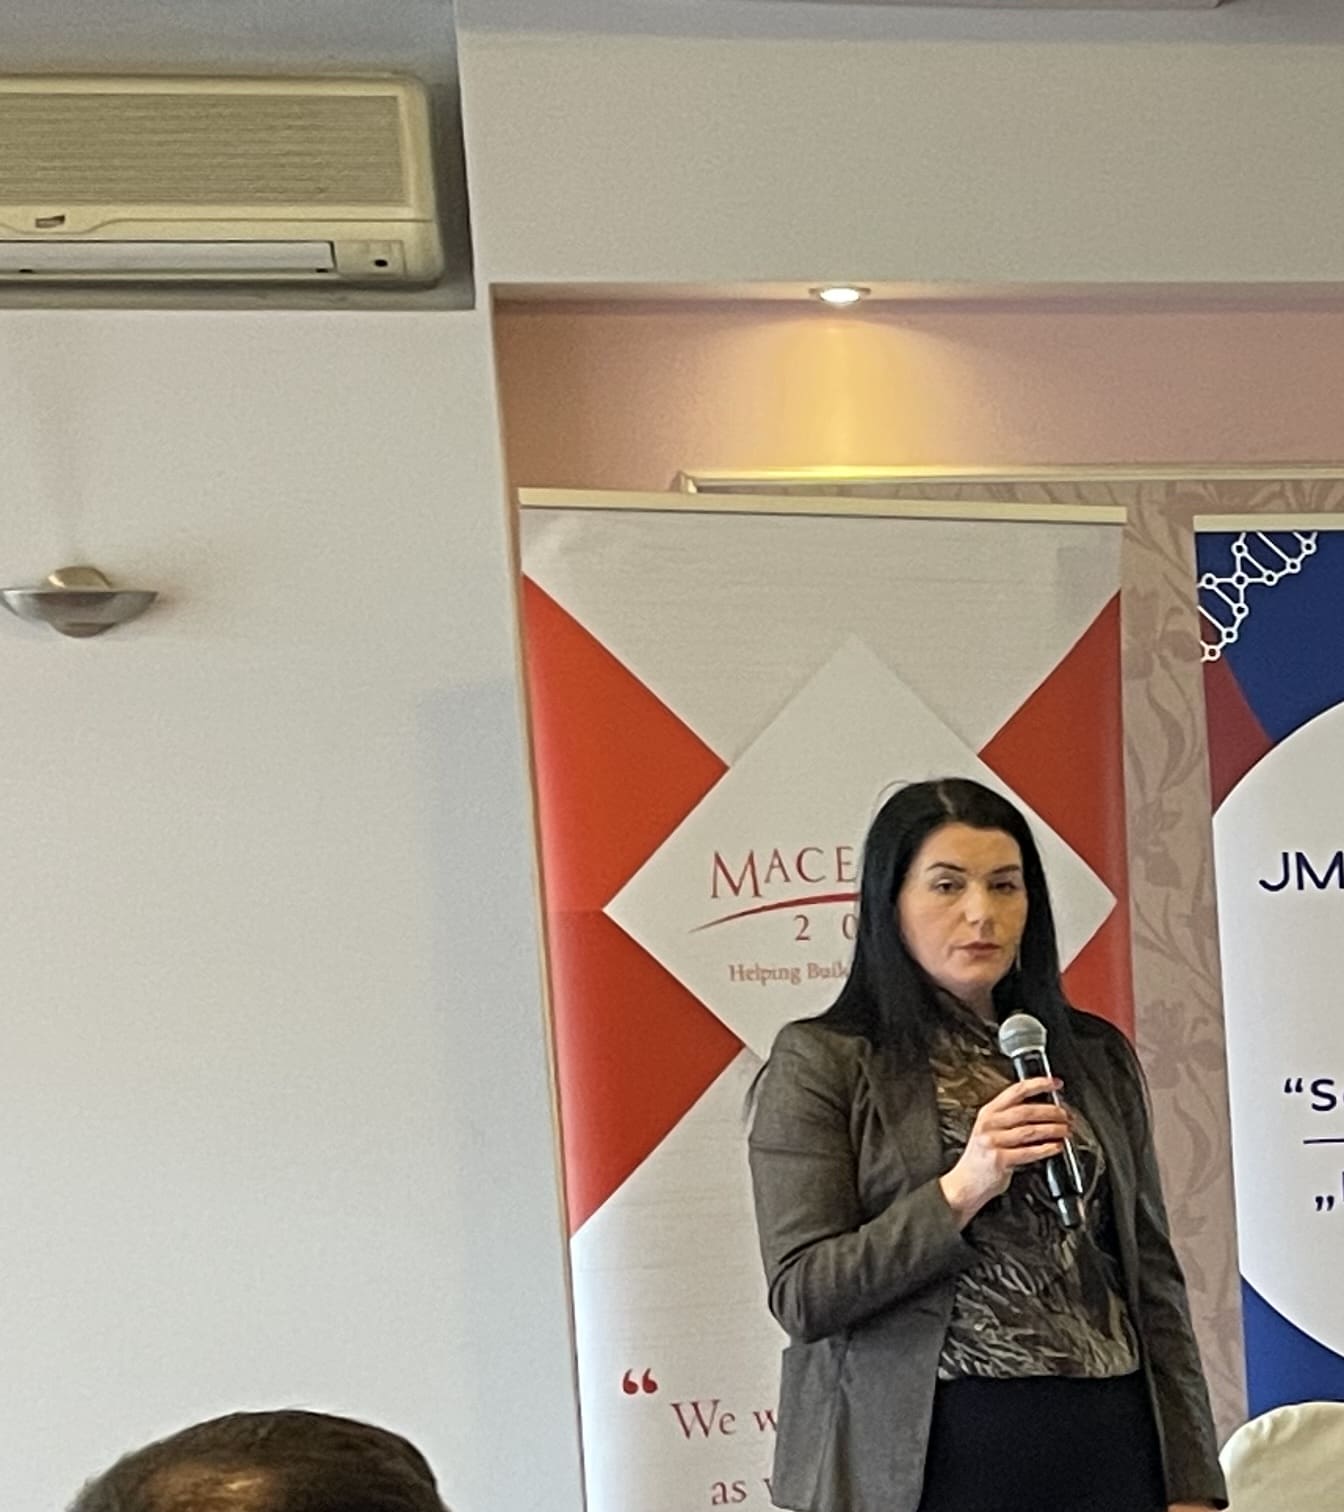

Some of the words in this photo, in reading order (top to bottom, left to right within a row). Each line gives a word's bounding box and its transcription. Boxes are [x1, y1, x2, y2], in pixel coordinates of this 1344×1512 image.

[711, 845, 858, 899] MACE
[728, 963, 803, 987] Helping
[670, 1399, 736, 1440] We
[711, 1479, 748, 1506] as
